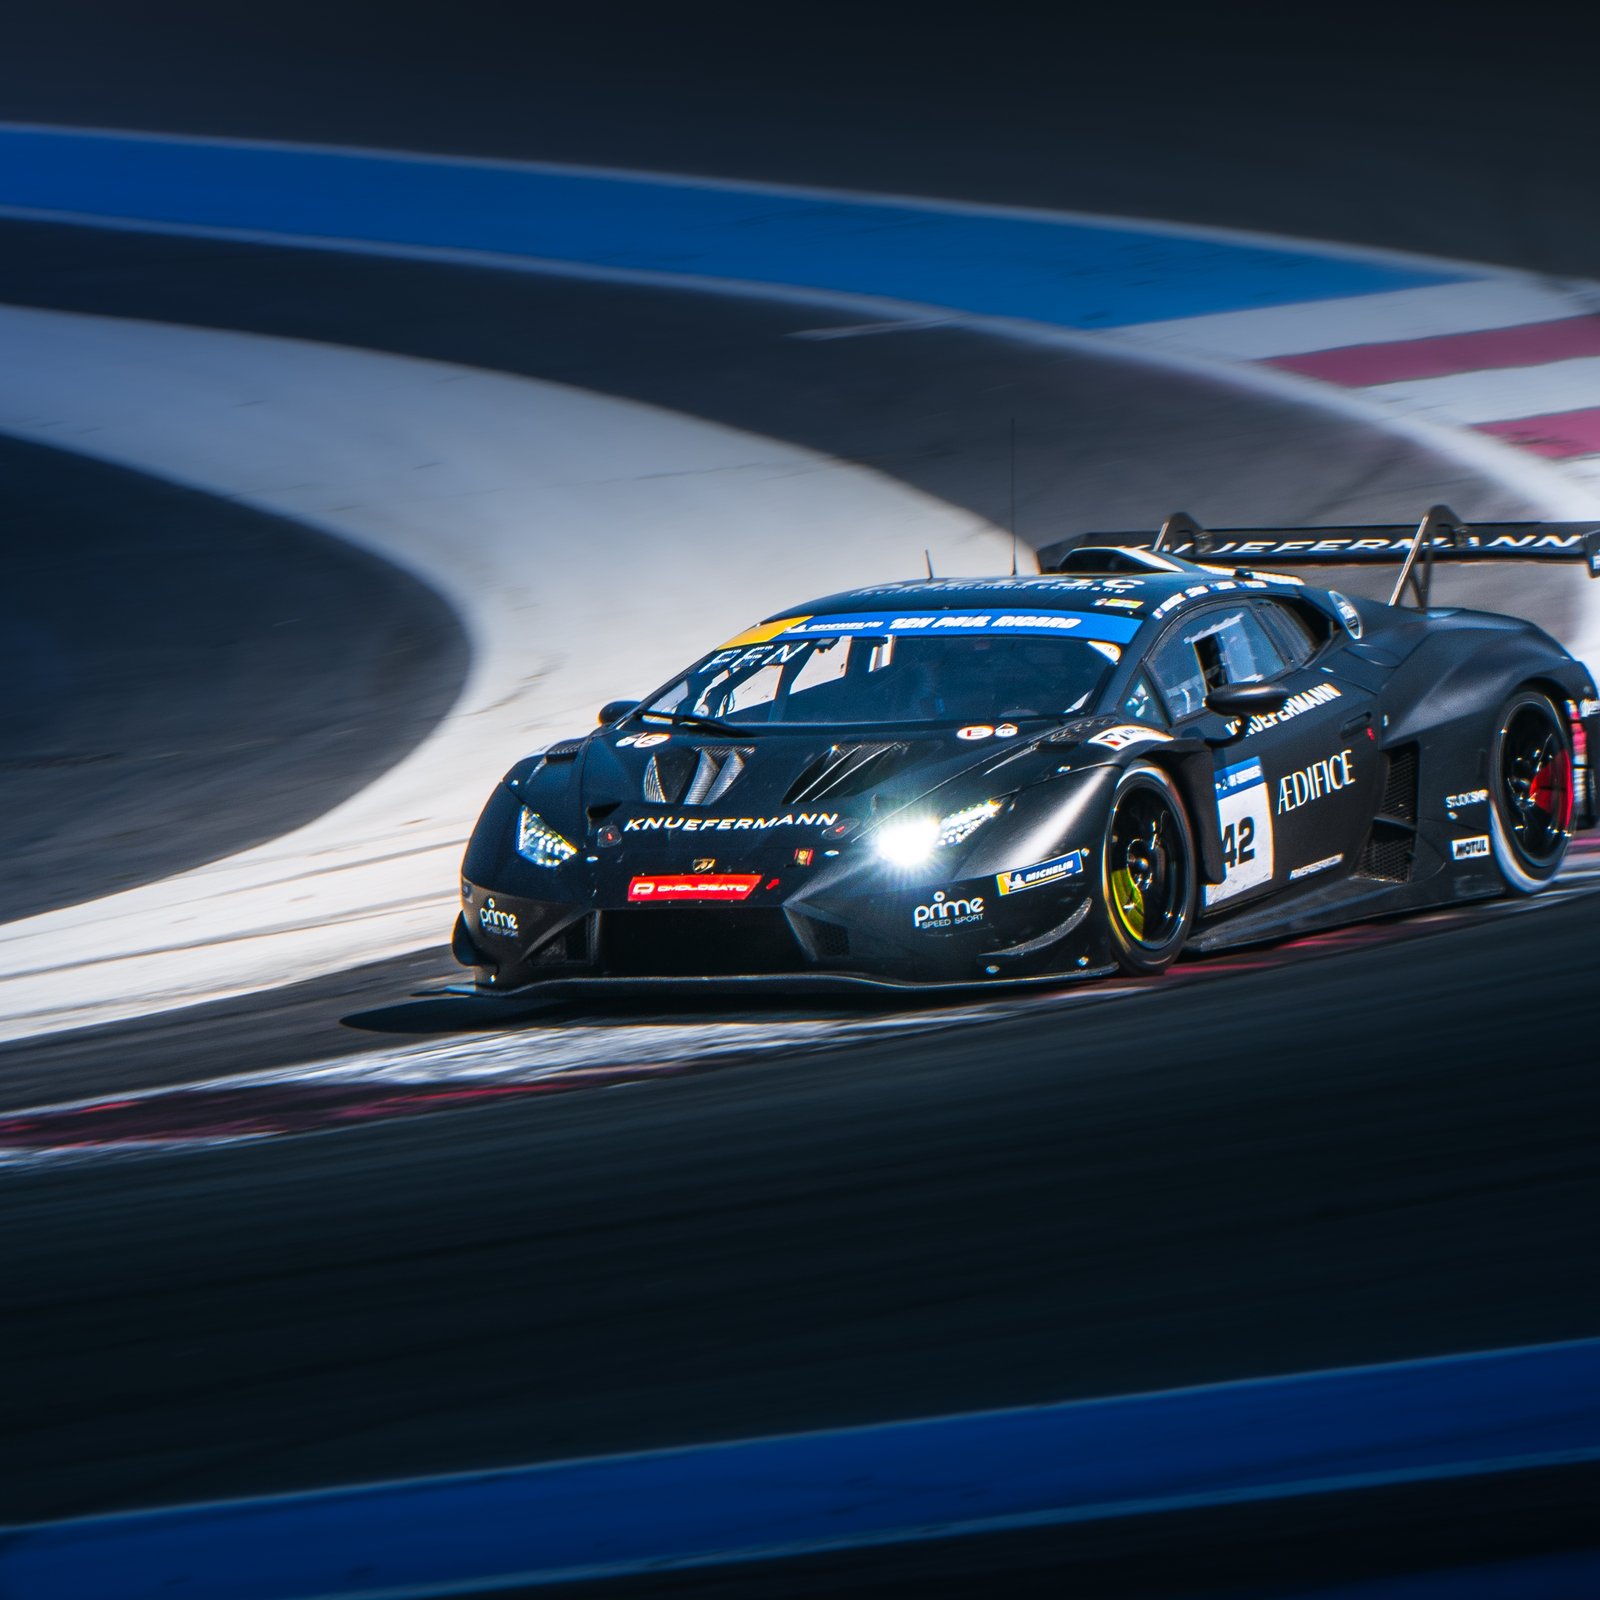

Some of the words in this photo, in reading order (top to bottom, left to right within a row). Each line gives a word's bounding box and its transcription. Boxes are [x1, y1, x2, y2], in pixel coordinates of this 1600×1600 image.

[1128, 534, 1583, 554] UEFERMNN
[1225, 682, 1342, 737] KUEFERMANN
[623, 812, 838, 833] KNUEFERMANN
[1222, 816, 1256, 869] 42
[1456, 839, 1487, 857] MOTUL
[1025, 860, 1075, 883] MICHELIN
[480, 897, 519, 930] prime
[913, 890, 985, 928] prime
[921, 918, 952, 929] SPEED
[955, 913, 985, 925] SPORT
